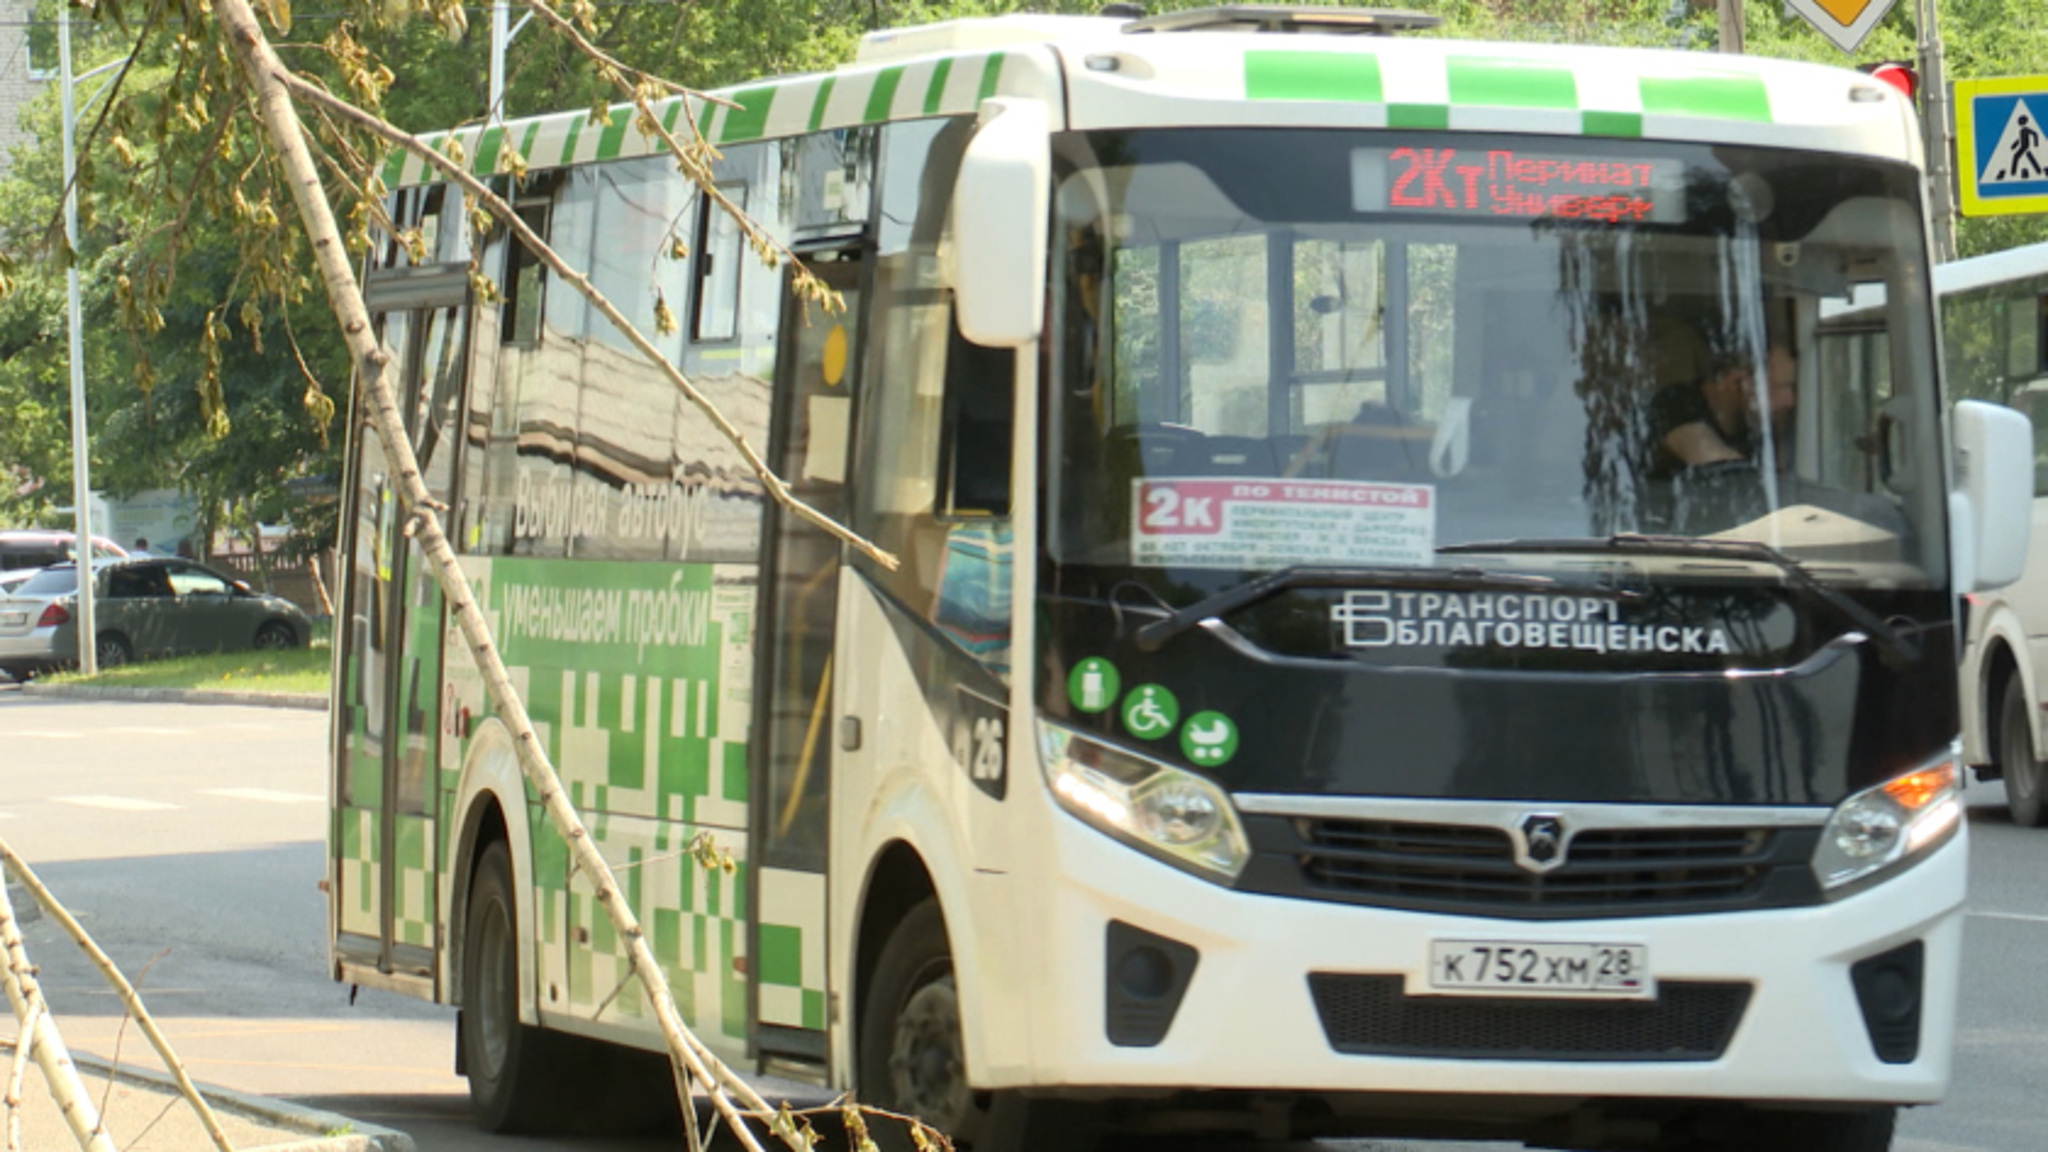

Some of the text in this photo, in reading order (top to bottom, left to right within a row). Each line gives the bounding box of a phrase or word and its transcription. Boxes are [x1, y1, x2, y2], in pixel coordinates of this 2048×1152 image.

[1487, 150, 1653, 186] Перинат
[515, 466, 608, 557] Выбирая
[1232, 484, 1420, 505] ПО ТЕНИСТОЙ
[500, 569, 709, 665] уменьшаем пробки
[1395, 592, 1619, 622] ТРАНСПОРТ
[1397, 619, 1730, 655] БЛАГОВЕЩЕНСКА
[973, 717, 1004, 779] 26
[1599, 949, 1632, 975] 28
